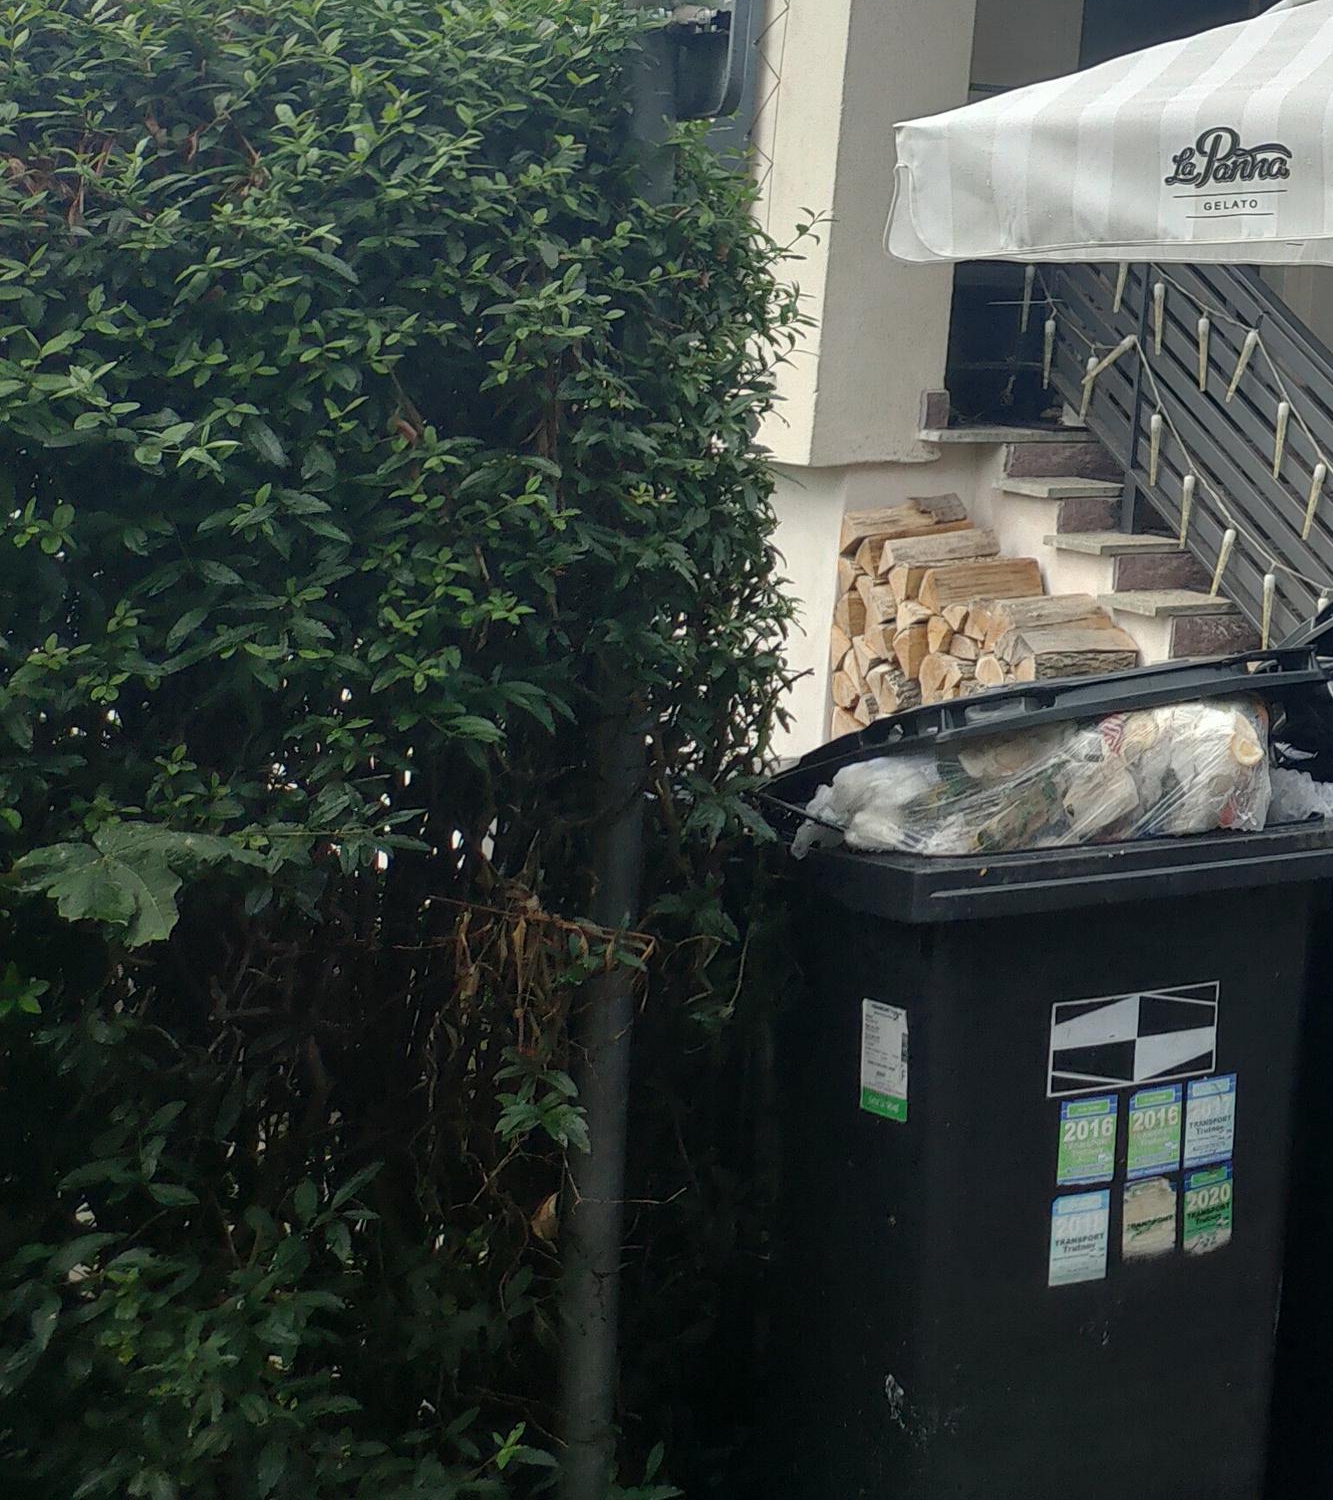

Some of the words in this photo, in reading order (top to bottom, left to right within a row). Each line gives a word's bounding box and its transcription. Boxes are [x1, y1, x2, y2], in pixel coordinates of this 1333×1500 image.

[1165, 147, 1202, 186] La
[1195, 127, 1292, 189] Panna
[1204, 200, 1258, 211] GELATO
[1064, 1117, 1113, 1142] 2016
[1132, 1105, 1178, 1133] 2016
[1189, 1115, 1232, 1129] TRANSPORT
[1188, 1183, 1230, 1212] 2020
[1055, 1233, 1104, 1247] TRANSPORT
